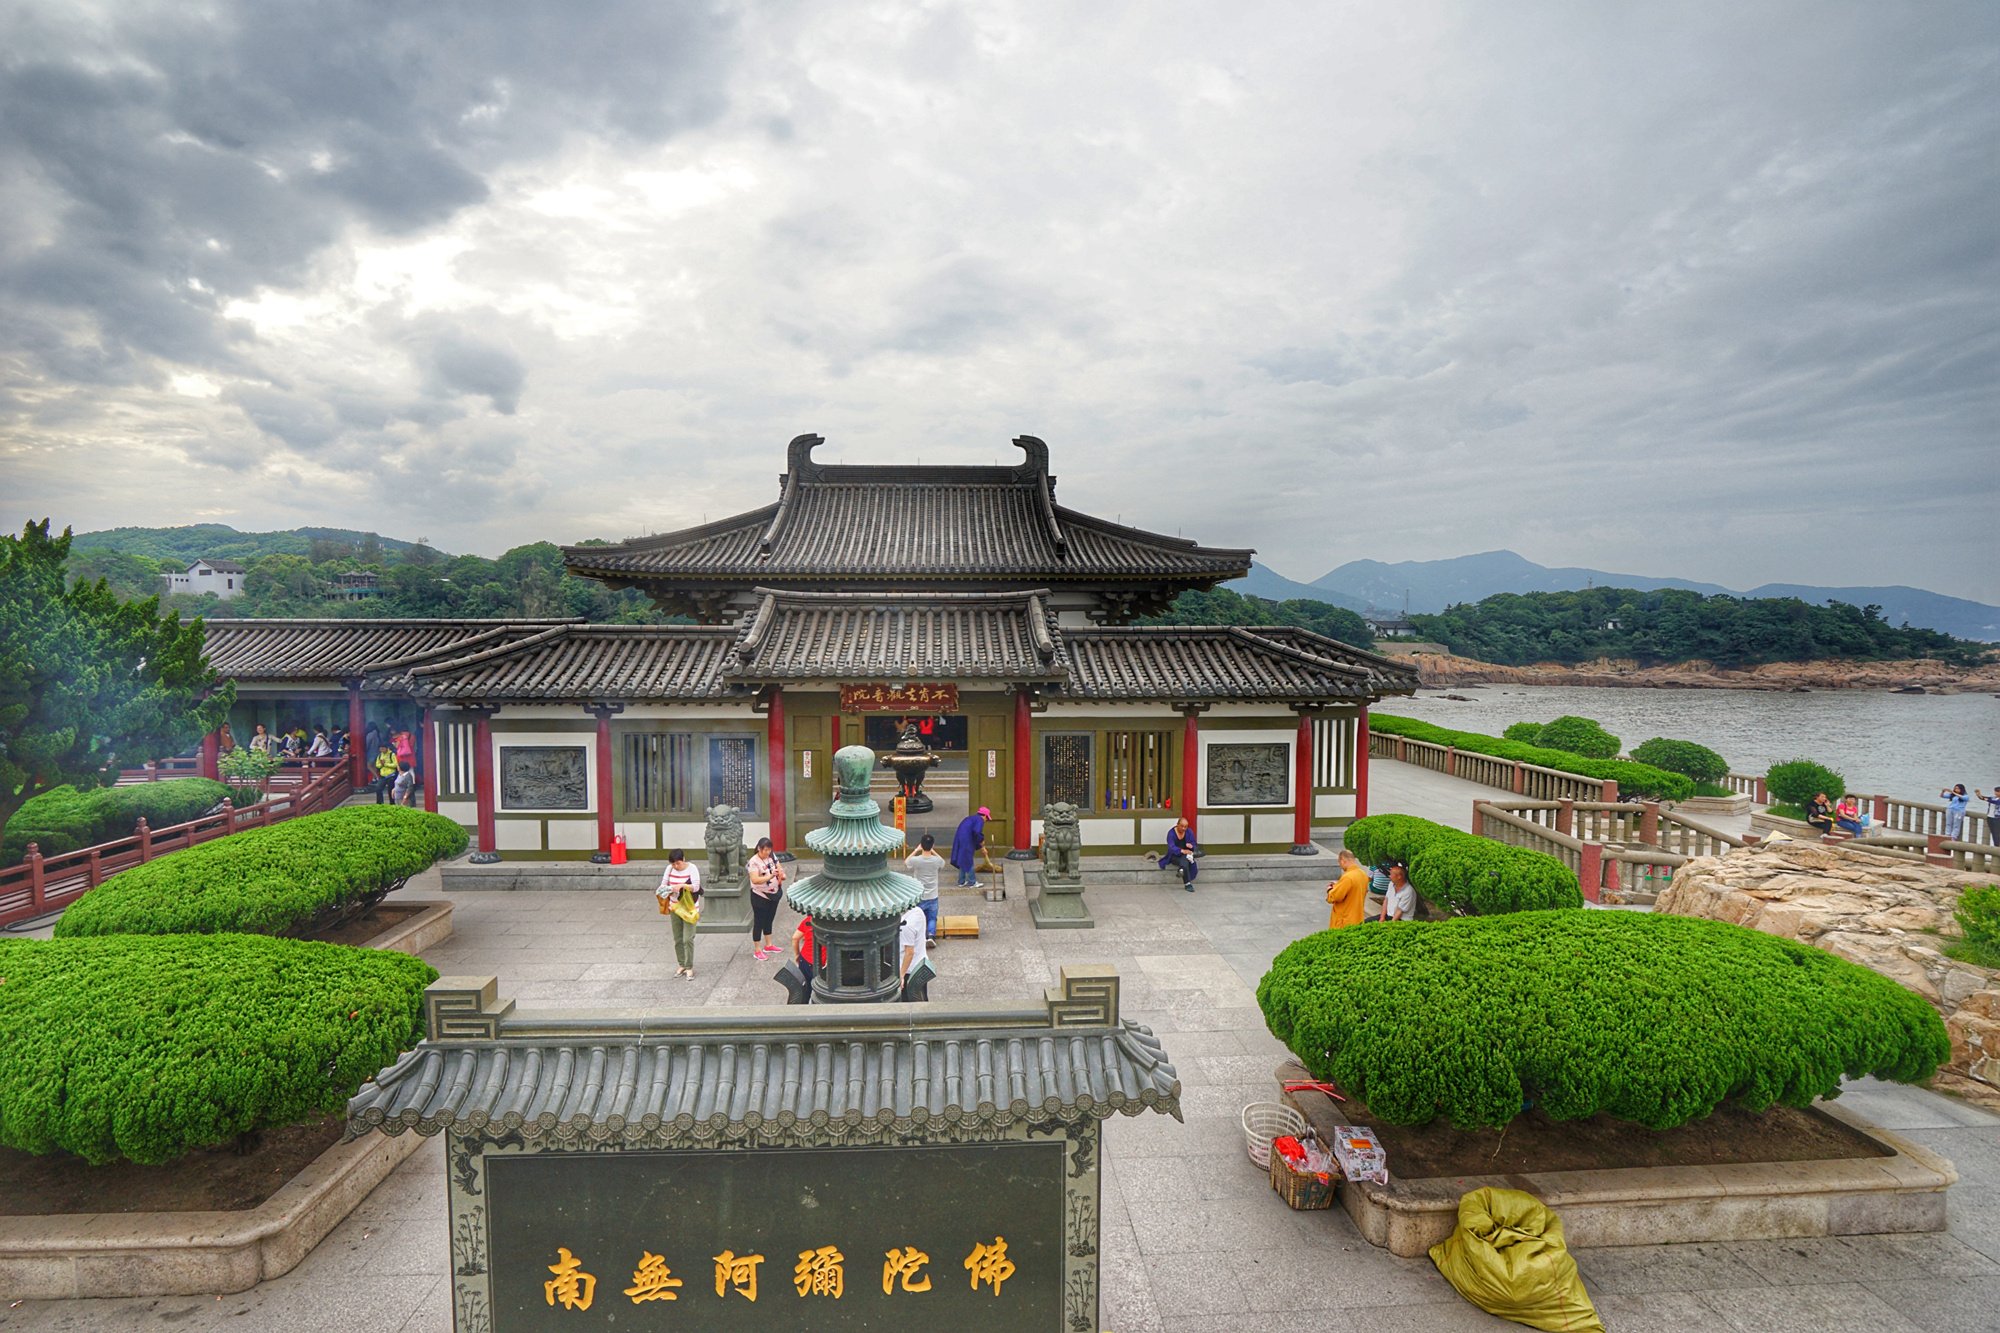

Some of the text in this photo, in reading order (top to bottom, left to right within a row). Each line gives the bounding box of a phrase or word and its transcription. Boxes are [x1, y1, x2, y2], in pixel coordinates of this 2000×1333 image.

[545, 1236, 1017, 1311] 南無阿彌陀佛
